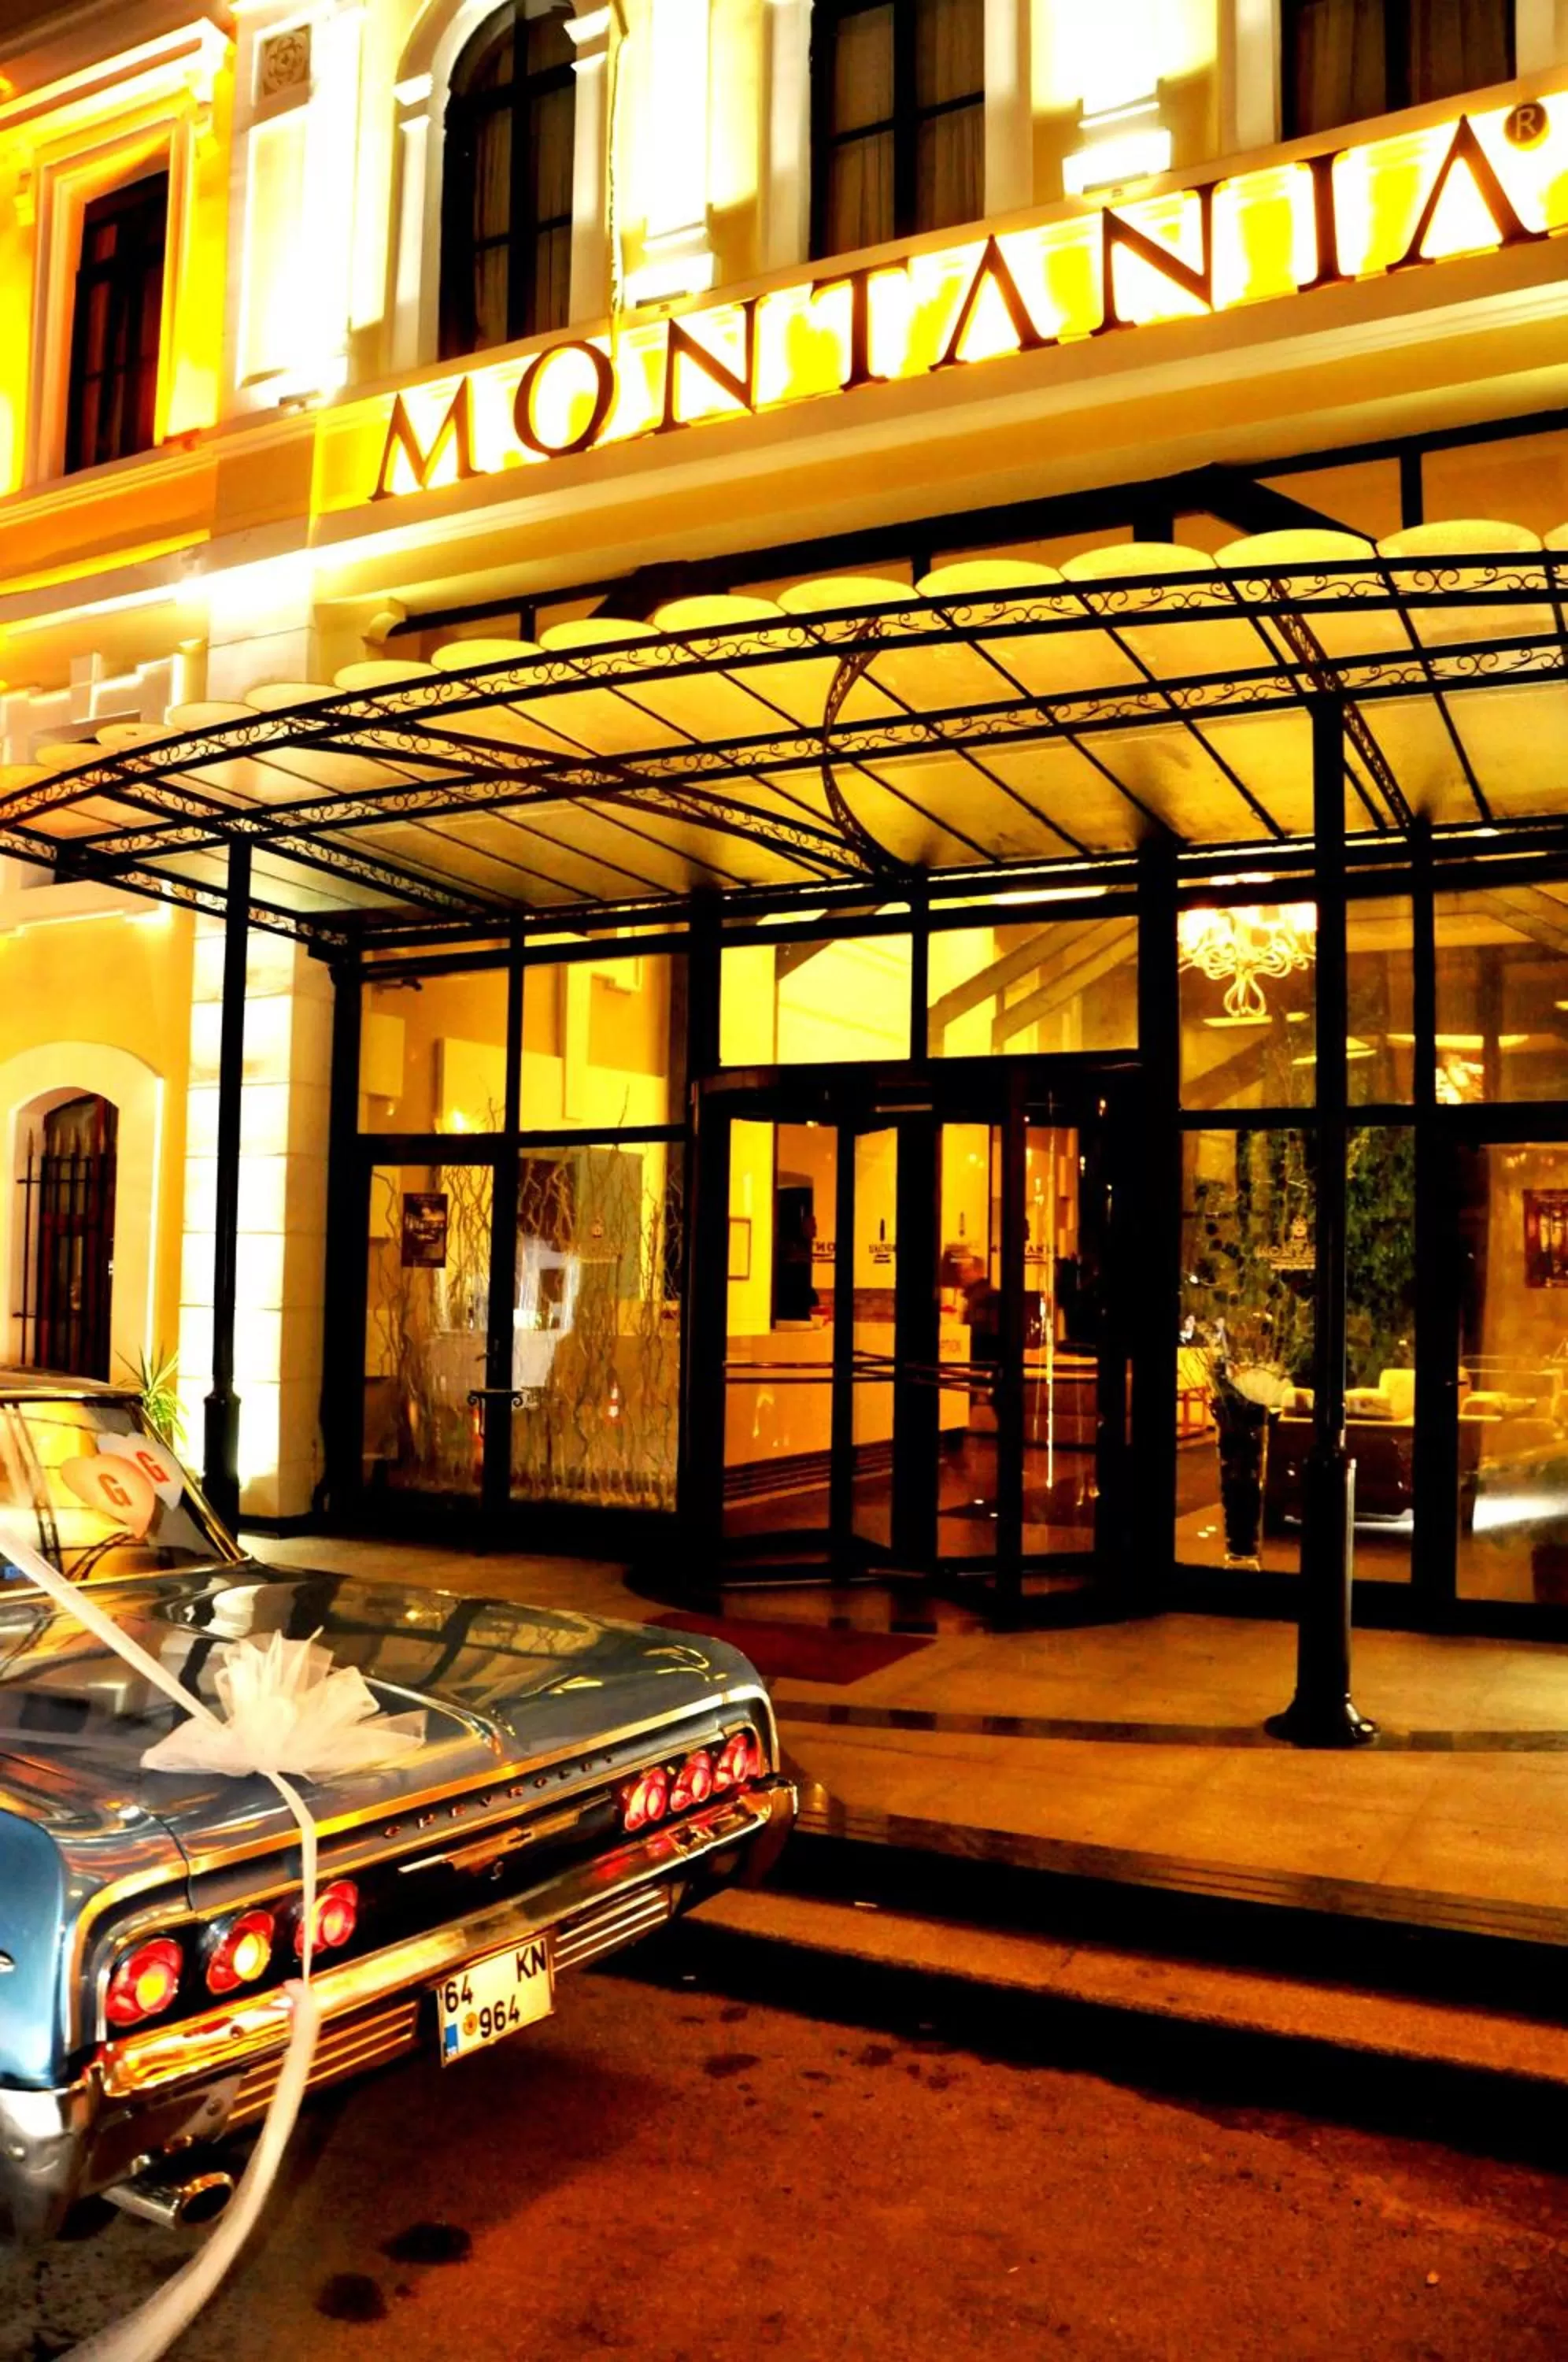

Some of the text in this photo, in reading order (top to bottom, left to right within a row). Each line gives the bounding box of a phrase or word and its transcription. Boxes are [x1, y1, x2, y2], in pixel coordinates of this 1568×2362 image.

[368, 113, 1550, 502] MONTANIA
[135, 1449, 170, 1483] G
[98, 1473, 132, 1507] G
[445, 1939, 546, 2013] 64 KN
[479, 1994, 520, 2038] 964
